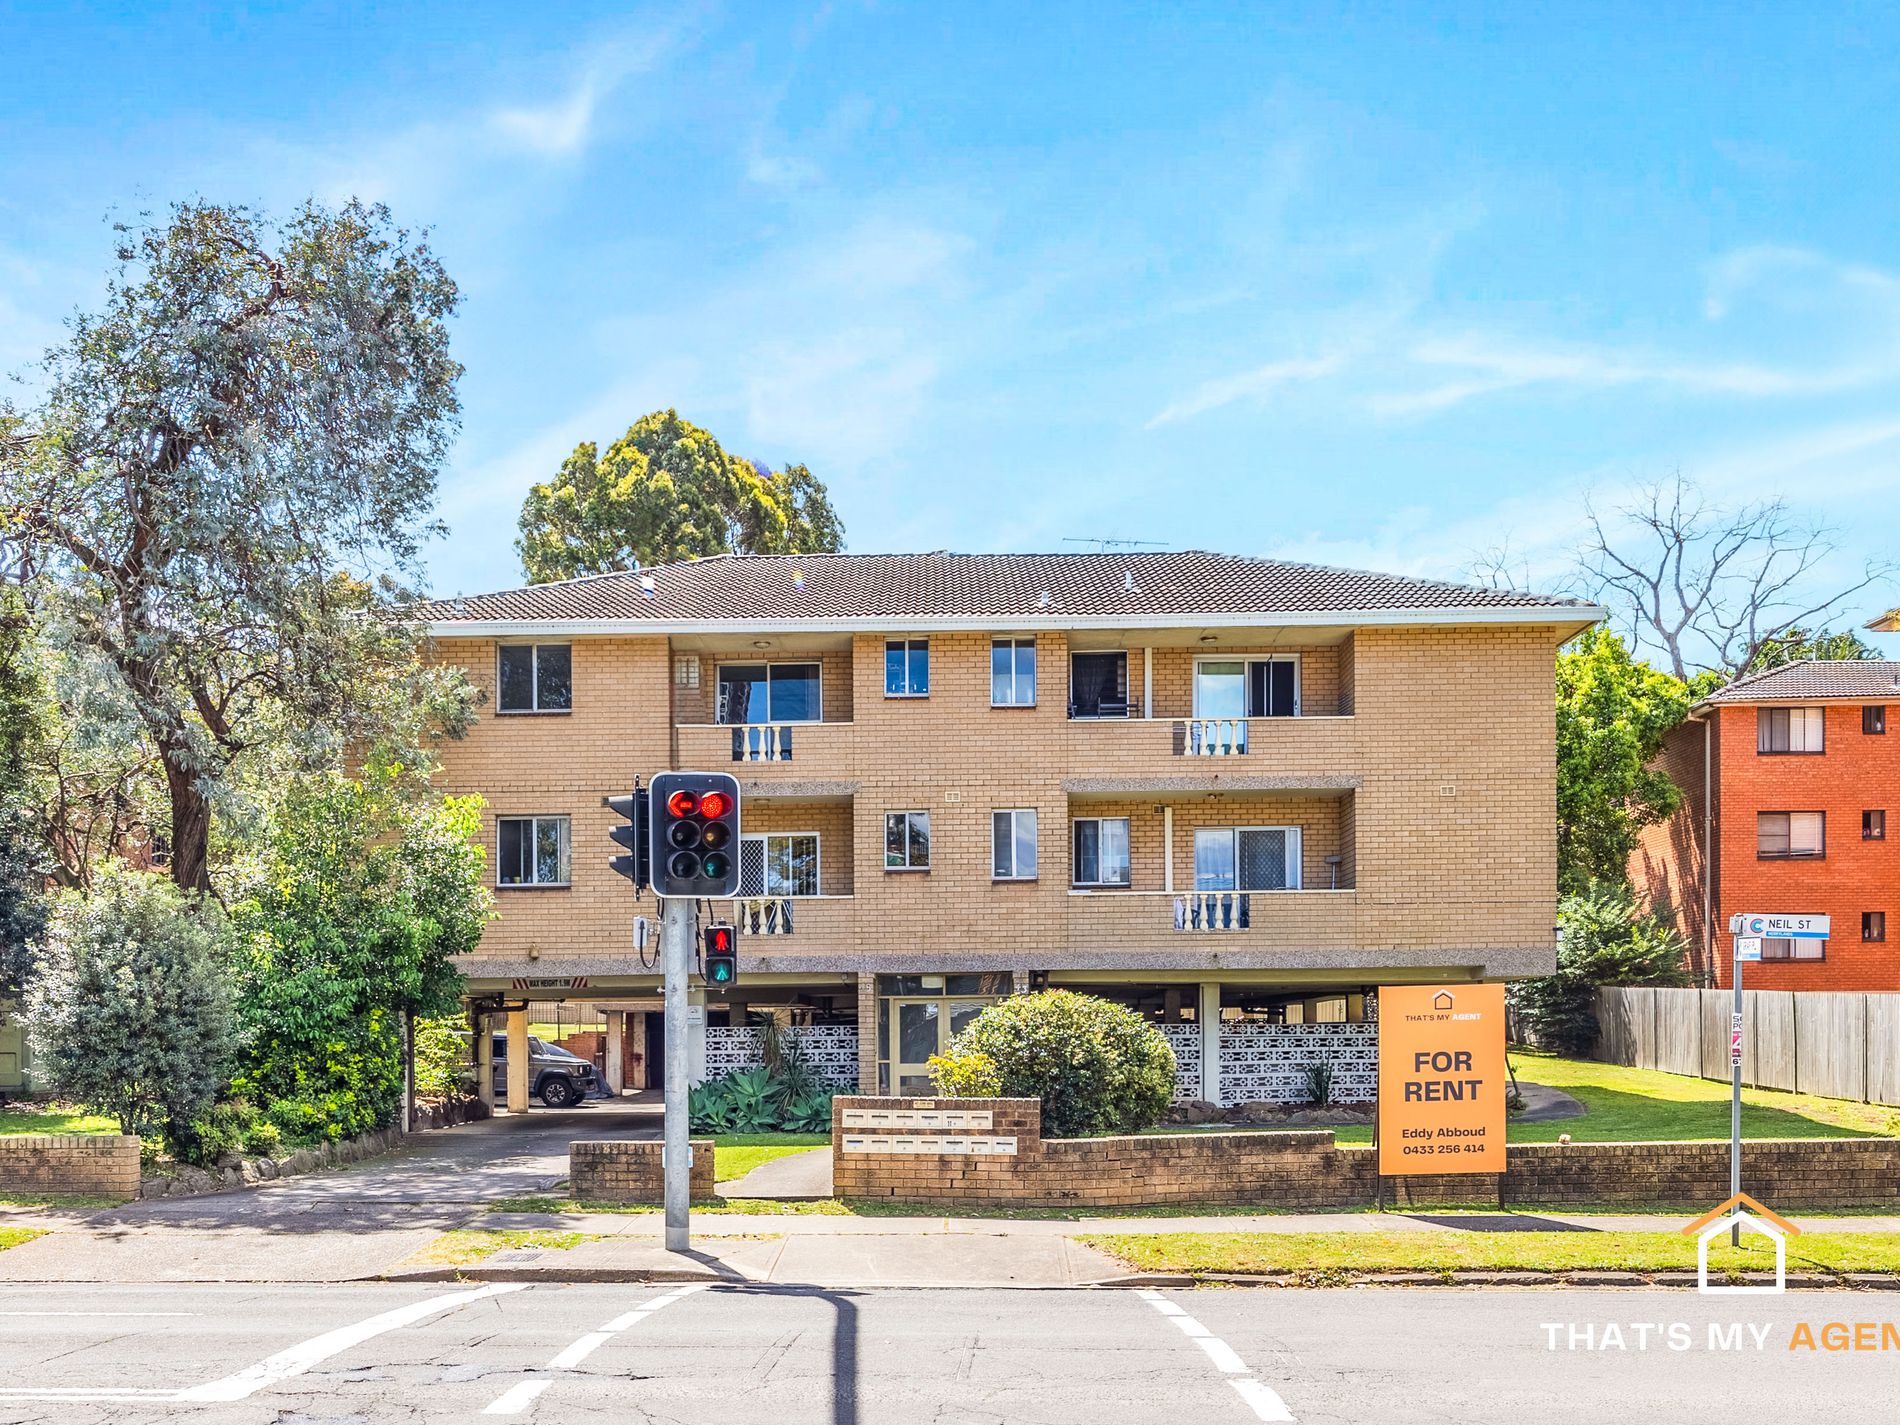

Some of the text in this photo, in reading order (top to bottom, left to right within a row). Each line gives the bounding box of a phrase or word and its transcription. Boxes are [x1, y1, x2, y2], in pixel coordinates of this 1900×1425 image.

[1768, 919, 1811, 930] NEIL ST
[540, 979, 558, 987] HEIGHT
[1405, 1014, 1434, 1022] THAT'S
[1452, 1012, 1482, 1021] AGENT
[1414, 1050, 1472, 1073] FOR
[1404, 1079, 1483, 1102] RENT
[1402, 1126, 1486, 1140] Eddy Abboud
[1403, 1143, 1486, 1155] 0433 256 414
